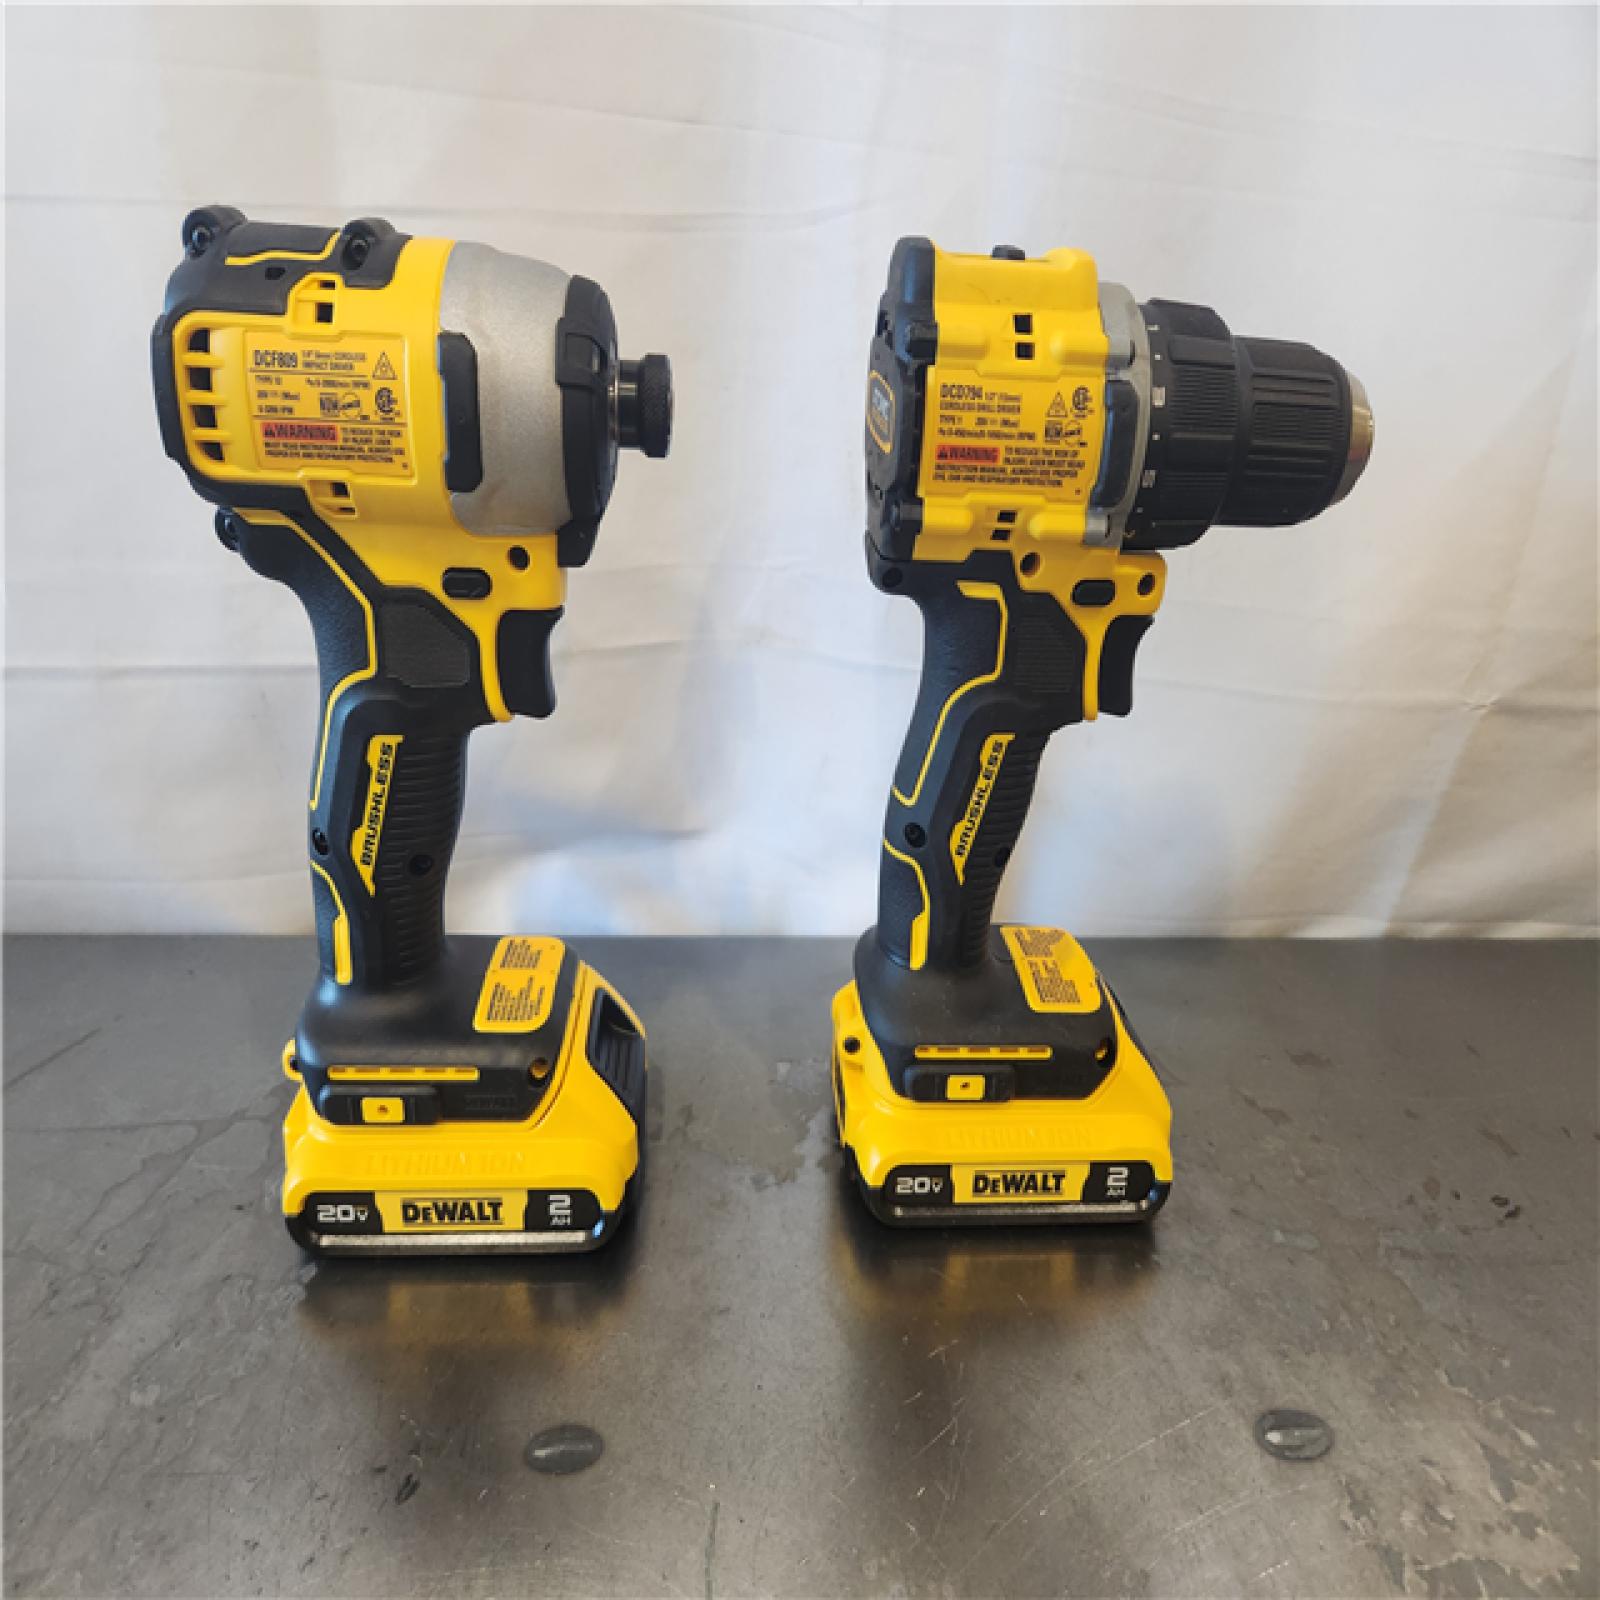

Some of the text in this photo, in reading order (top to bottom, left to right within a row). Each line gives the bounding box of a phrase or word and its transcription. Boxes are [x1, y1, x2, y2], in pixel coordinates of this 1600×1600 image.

[254, 349, 298, 368] DCF809
[940, 383, 983, 401] DCD794
[275, 424, 337, 441] WARNING
[949, 446, 999, 462] WARNING
[360, 741, 393, 867] BRUSHLESS
[955, 740, 1004, 858] BRUSHLESS
[1106, 1166, 1129, 1187] 2
[548, 1194, 572, 1216] 2
